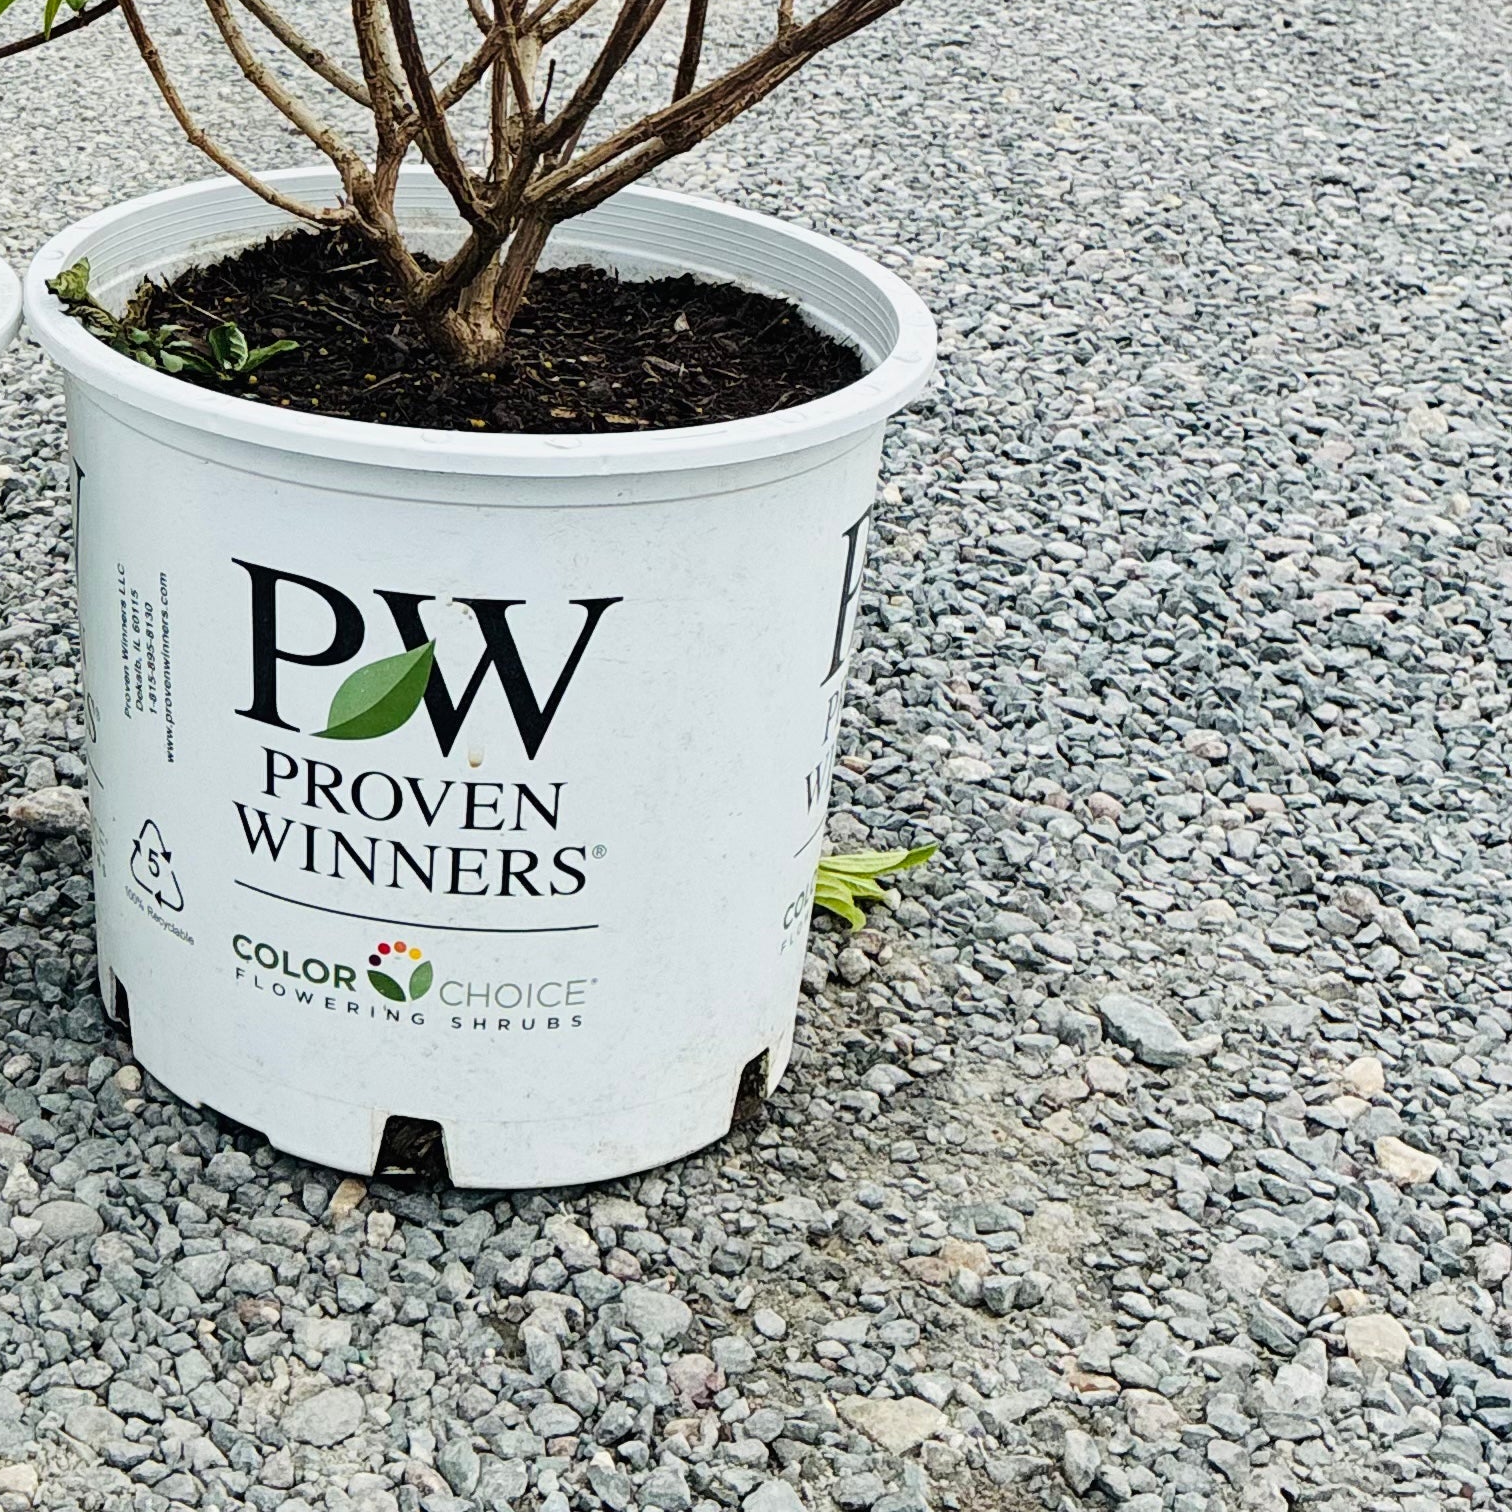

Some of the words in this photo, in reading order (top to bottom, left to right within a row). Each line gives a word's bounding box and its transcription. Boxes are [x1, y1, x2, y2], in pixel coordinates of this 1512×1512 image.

[117, 562, 126, 596] LLC
[119, 599, 129, 660] Winners
[130, 587, 141, 634] 60115
[132, 638, 142, 653] IL
[144, 601, 158, 715] 1-815-895-8130
[159, 571, 176, 763] www.provenwinners.com
[231, 557, 625, 760] PW
[123, 665, 132, 719] Proven
[260, 745, 568, 831] PROVEN
[147, 848, 160, 878] 5
[146, 905, 196, 946] Recyclable
[232, 934, 357, 992] COLOR
[235, 967, 426, 1026] FLOWERING
[451, 1015, 583, 1032] SHRUBS
